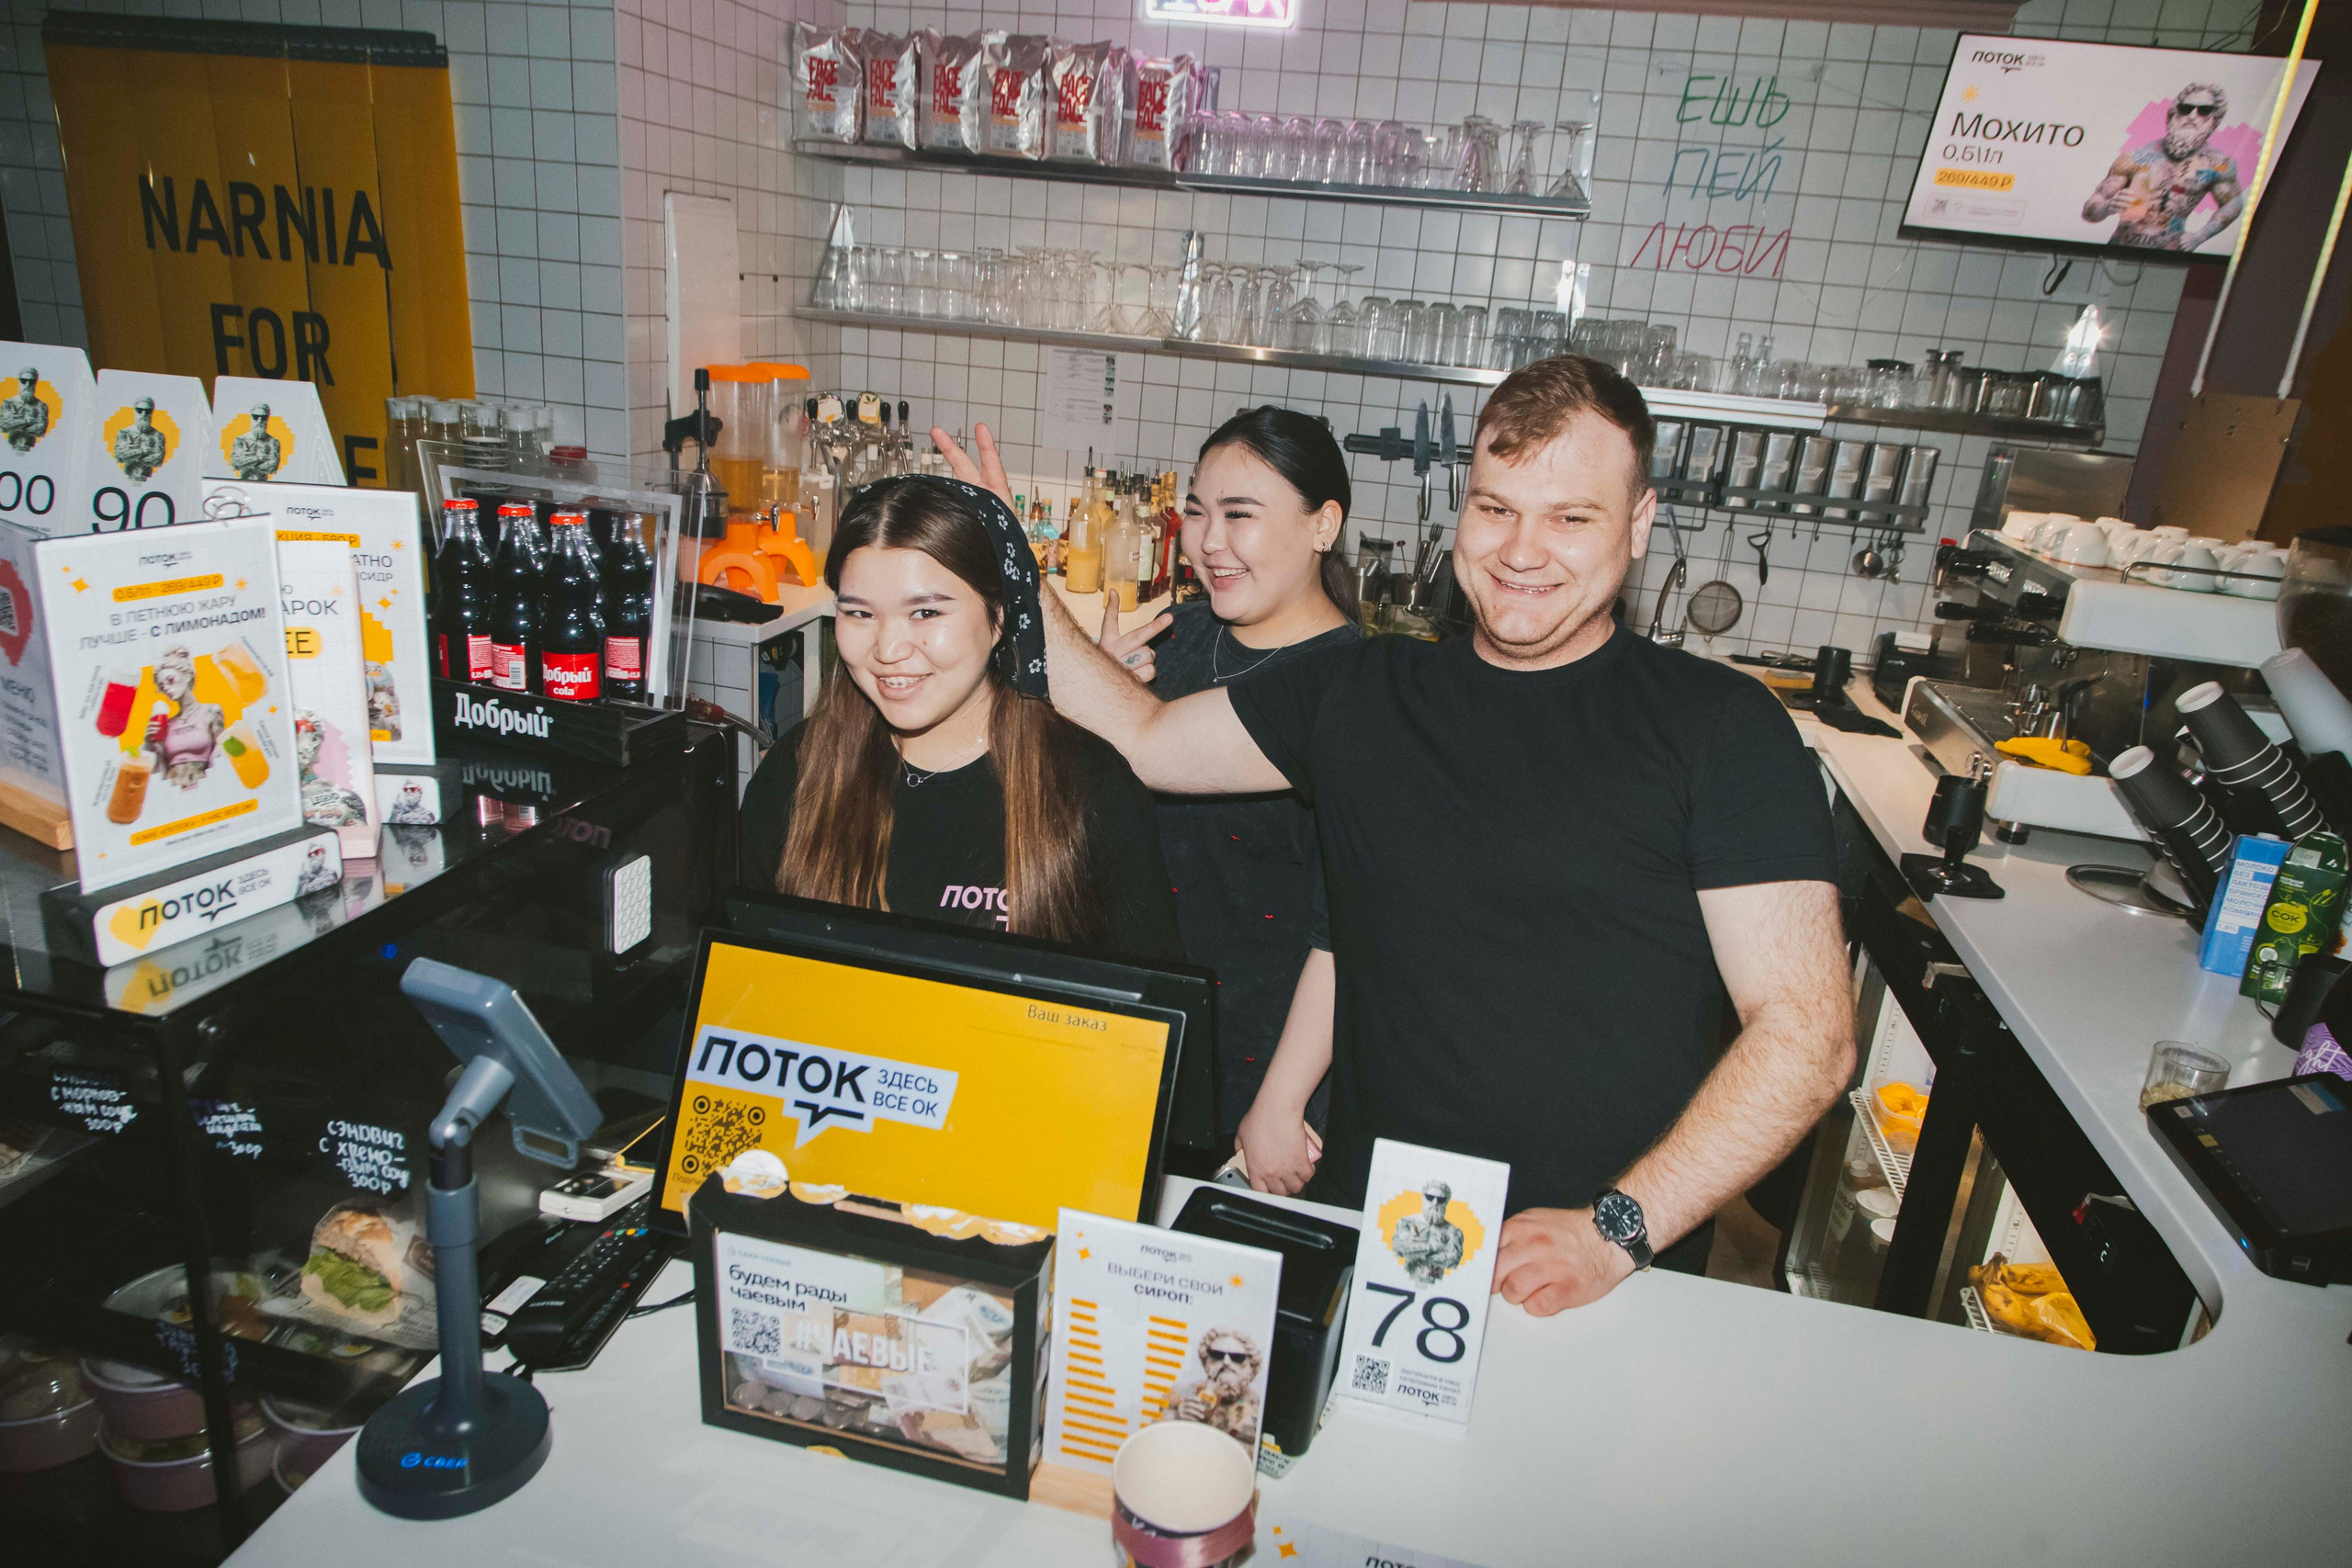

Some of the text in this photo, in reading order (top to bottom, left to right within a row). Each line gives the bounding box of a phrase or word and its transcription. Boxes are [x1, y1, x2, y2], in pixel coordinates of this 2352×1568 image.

[1971, 51, 2025, 65] ПОТОК
[1676, 75, 1791, 128] ЕШЬ
[1662, 137, 1786, 204] ПЕЙ
[1938, 172, 1999, 188] 269/449
[139, 175, 393, 271] NARNIA
[1630, 220, 1792, 277] ЛЮБИ
[210, 303, 334, 386] FOR
[91, 486, 175, 534] 90
[287, 507, 321, 516] ПОТОК
[277, 533, 312, 541] КЦИЯ
[139, 553, 175, 566] ПОТОК
[353, 554, 393, 568] АТНО
[110, 595, 237, 626] В ЛЕТНЮЮ ЖАРУ
[282, 600, 338, 615] АРОК
[79, 607, 266, 650] ЛУЧШЕ С ЛИМОНАДОМ!
[543, 663, 593, 685] Добрый
[553, 686, 575, 696] cola
[455, 693, 550, 738] Добрый
[2233, 870, 2250, 878] БЕЗ
[2236, 861, 2274, 873] МОЛОКО
[139, 879, 236, 931] ПОТОК
[939, 885, 1009, 912] ПОТО
[2226, 897, 2264, 908] МОЛОЧН
[2228, 888, 2267, 900] БРЯНСКО
[2223, 907, 2260, 918] КОМБИН
[2270, 909, 2301, 924] СОК
[1027, 1004, 1108, 1032] Ваш заказ
[696, 1035, 871, 1103] ПОТОК
[877, 1068, 938, 1094] ЗДЕСЬ
[873, 1091, 940, 1118] ВСЕ ОК
[672, 1172, 702, 1186] Подпи
[1140, 1245, 1178, 1258] ПОТОК
[729, 1264, 848, 1303] будем рады
[1107, 1262, 1224, 1296] ВЫБЕРИ СВОЙ
[730, 1286, 807, 1313] чаевым
[1134, 1283, 1194, 1305] СИРОП:
[1366, 1281, 1471, 1364] 78
[795, 1319, 935, 1377] #ЧАЕВЫЕ
[1397, 1384, 1440, 1402] ПОТОК
[1365, 1556, 1417, 1568] ПОТ
